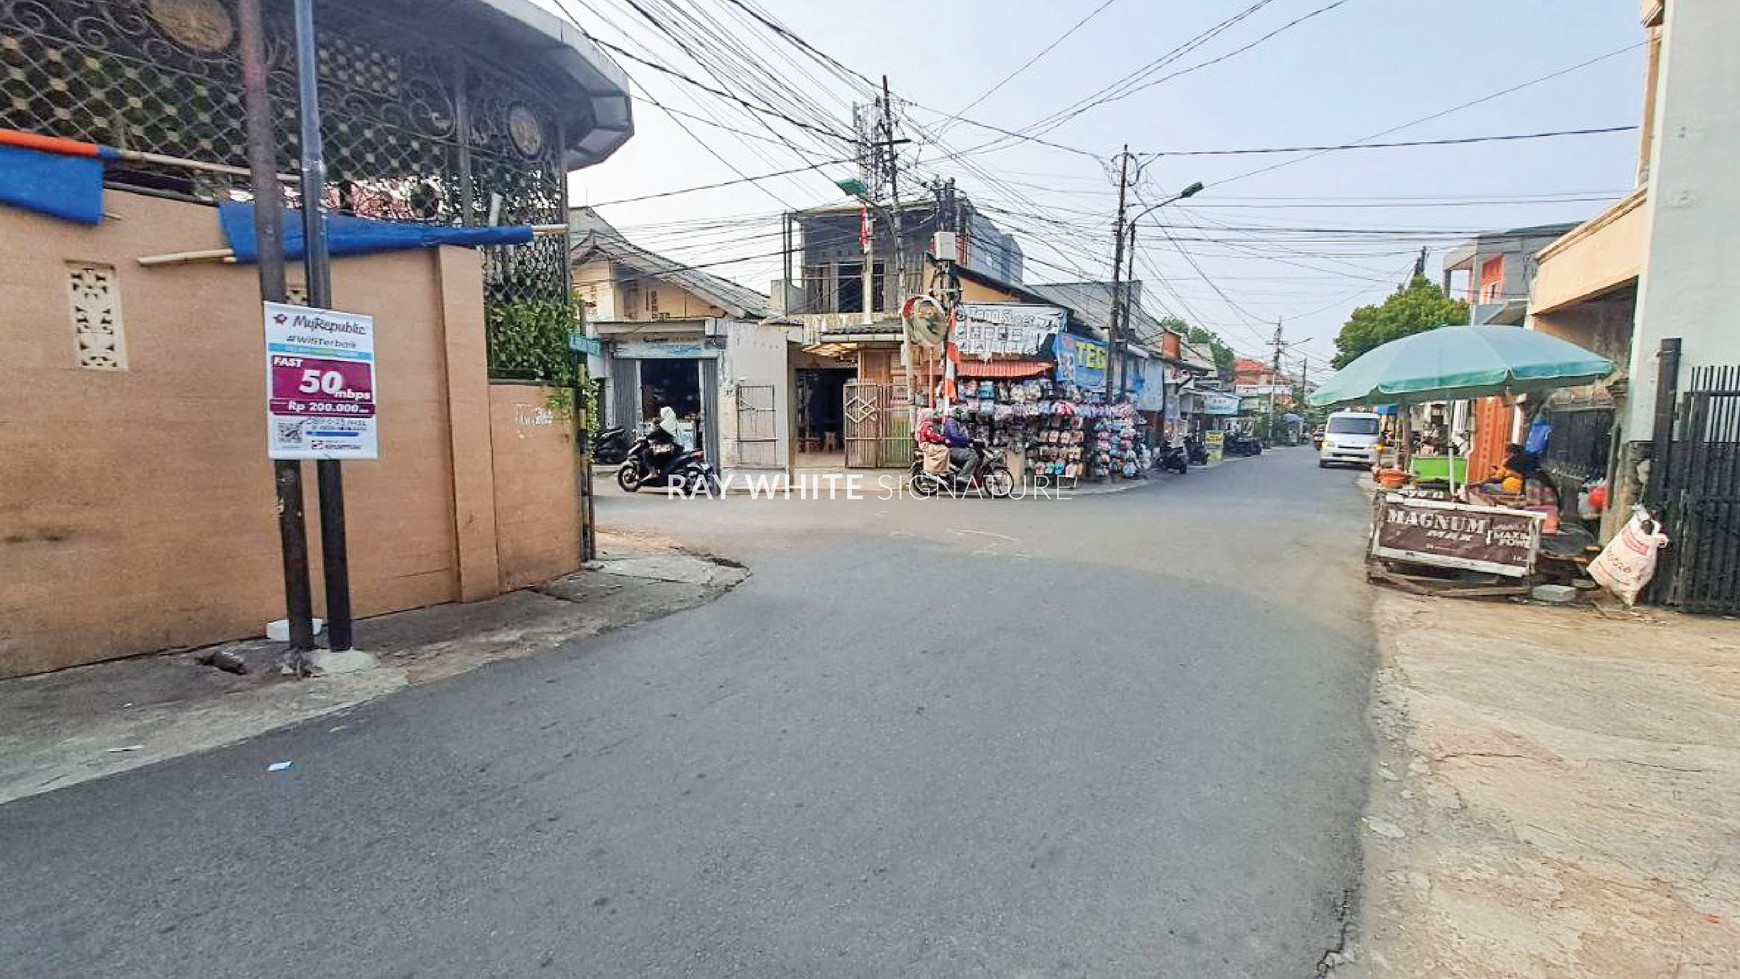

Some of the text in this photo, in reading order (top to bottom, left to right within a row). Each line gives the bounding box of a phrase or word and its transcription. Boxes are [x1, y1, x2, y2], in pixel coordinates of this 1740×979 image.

[293, 314, 366, 335] MyRepublic
[273, 356, 304, 368] FAST
[298, 369, 371, 401] 50 mbps
[288, 400, 360, 413] Rp 200.000
[1386, 509, 1488, 534] MAGNUM
